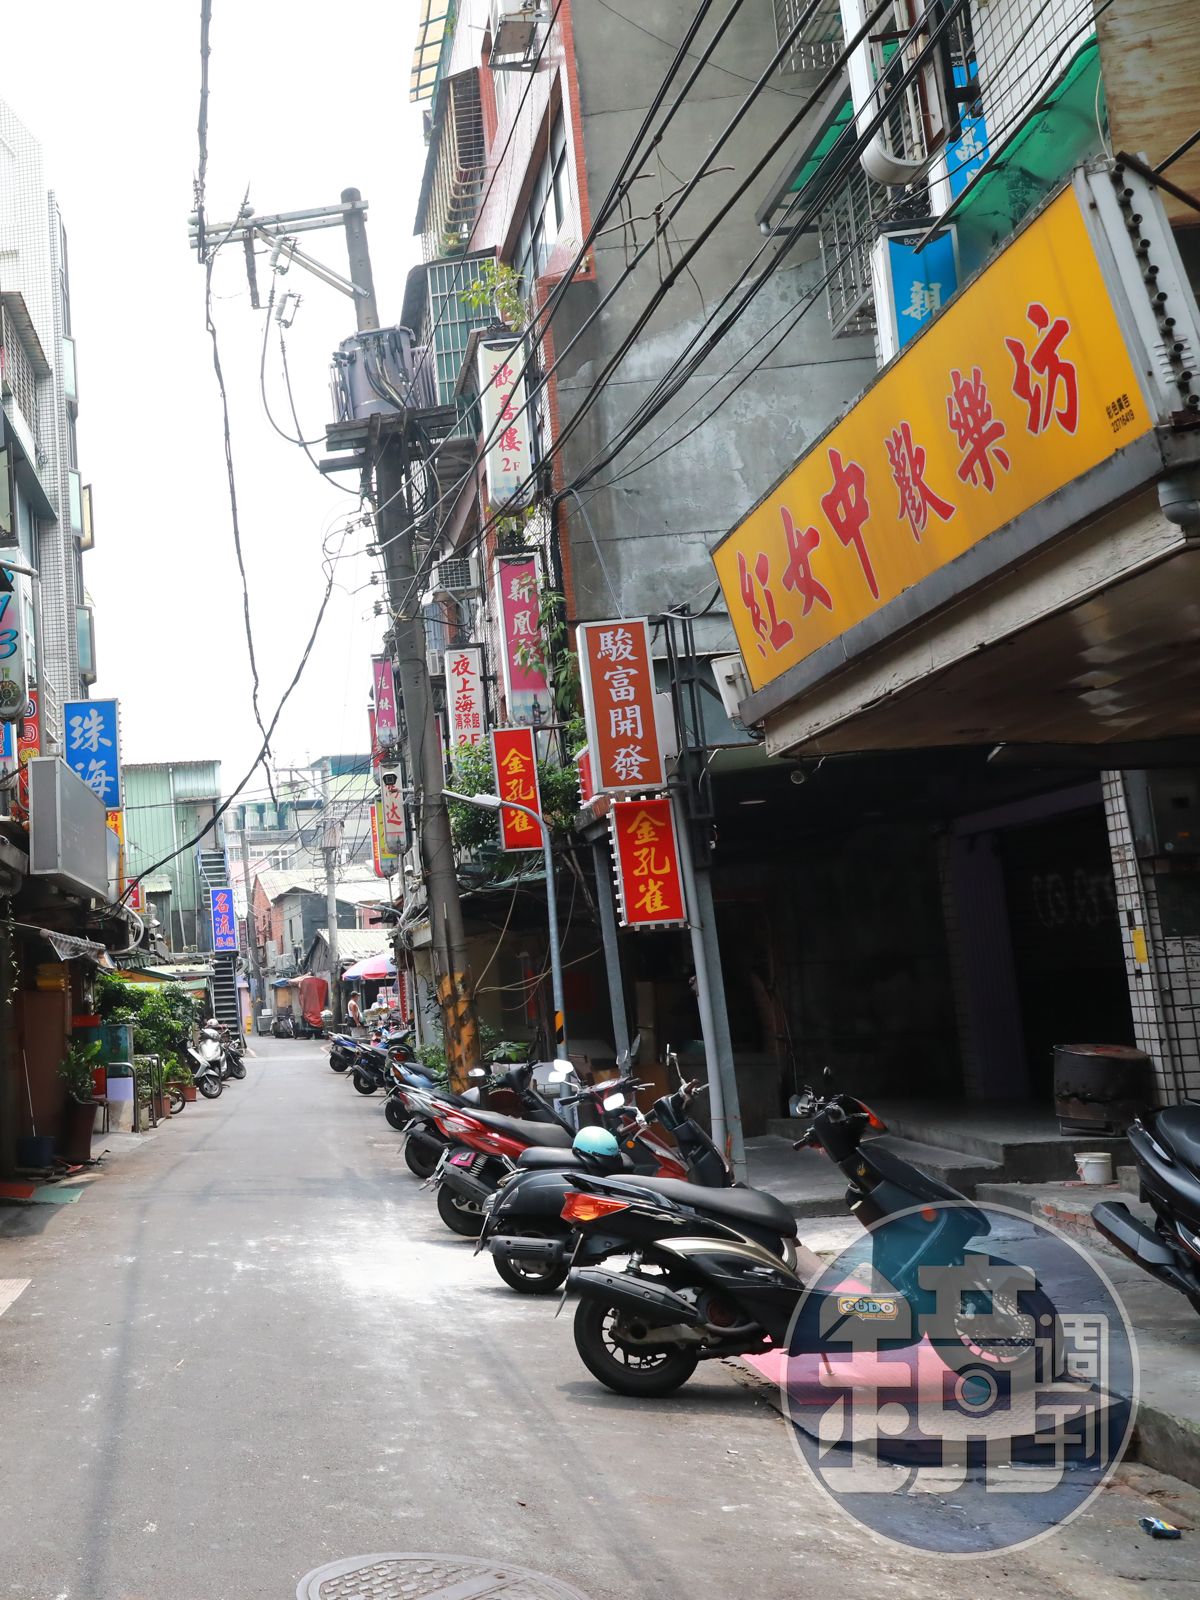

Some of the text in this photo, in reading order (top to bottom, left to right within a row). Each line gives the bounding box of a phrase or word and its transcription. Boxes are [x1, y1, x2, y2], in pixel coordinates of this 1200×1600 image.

[501, 457, 521, 473] 2F
[451, 654, 477, 713] 夜上海
[596, 629, 651, 783] 駿富開發
[69, 708, 116, 800] 珠海
[501, 748, 535, 833] 金孔雀
[625, 808, 673, 915] 金孔雀
[213, 892, 235, 935] 名流
